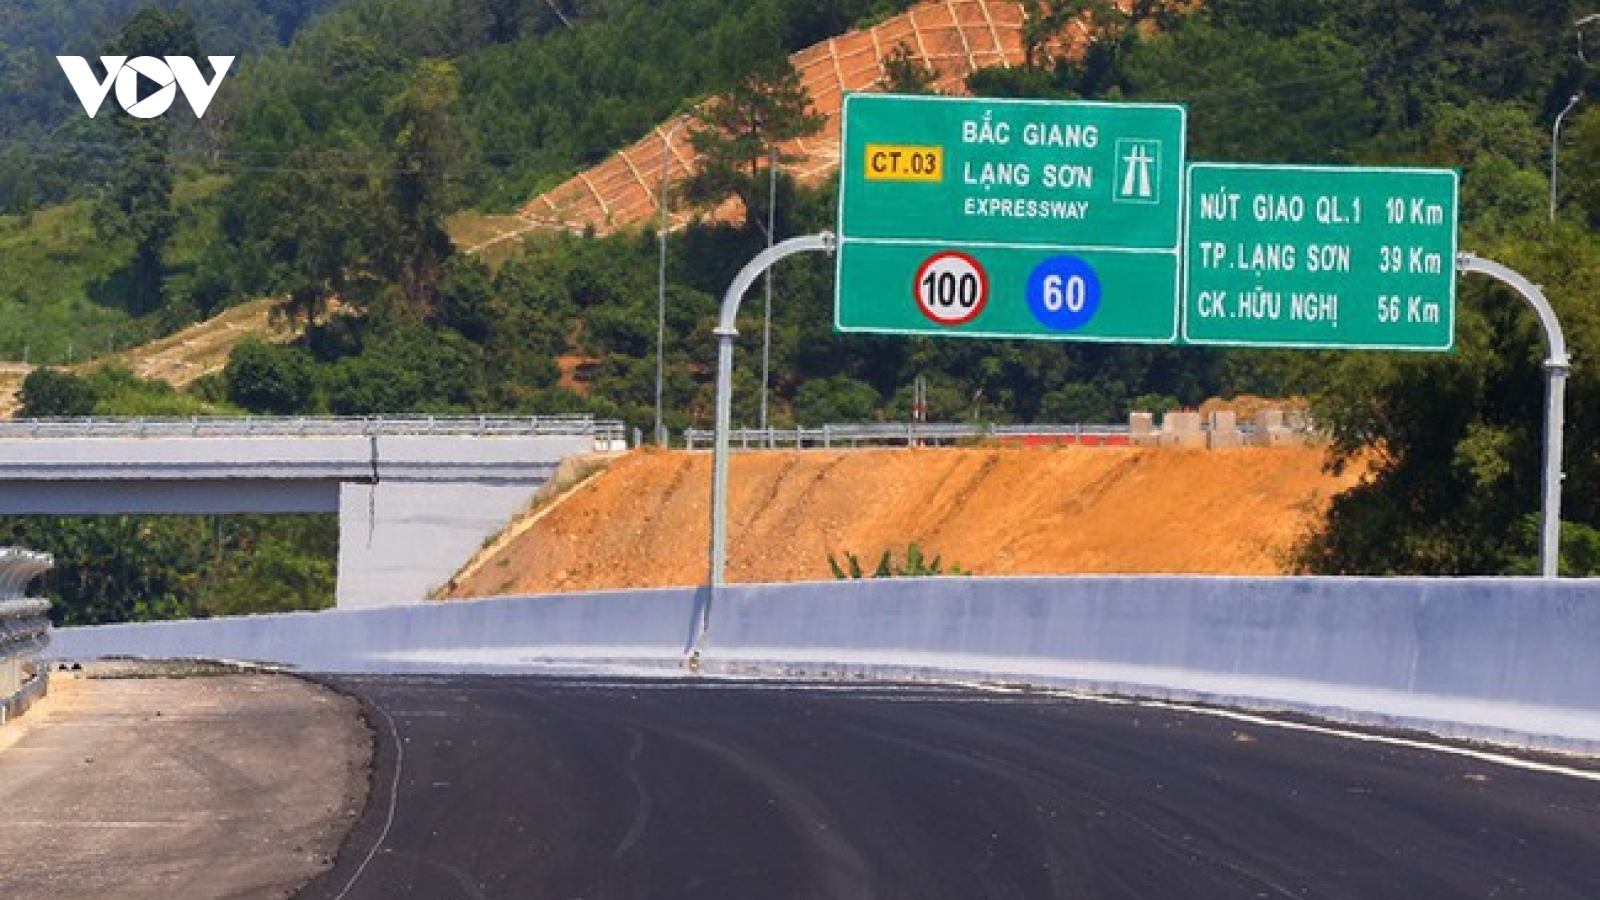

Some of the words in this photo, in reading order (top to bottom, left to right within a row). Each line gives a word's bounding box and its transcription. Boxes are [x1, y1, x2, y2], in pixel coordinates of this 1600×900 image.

[962, 109, 1010, 143] BẮC
[1023, 123, 1099, 148] GIANG
[871, 151, 937, 174] CT.03
[964, 162, 1030, 190] LẠNG
[1043, 163, 1093, 189] SƠN
[964, 198, 1089, 219] EXPRESSWAY
[1200, 186, 1241, 220] NÚT
[1253, 195, 1304, 222] GIAO
[1316, 195, 1362, 224] QL.1
[1385, 197, 1404, 224] 10
[1410, 198, 1443, 226] Km
[1307, 243, 1350, 272] SƠN
[1380, 245, 1402, 273] 39
[1409, 246, 1441, 274] Km
[922, 271, 979, 308] 100
[1043, 274, 1086, 312] 60
[1290, 293, 1338, 328] NGHỊ
[1377, 295, 1400, 323] 56
[1407, 295, 1440, 324] Km
